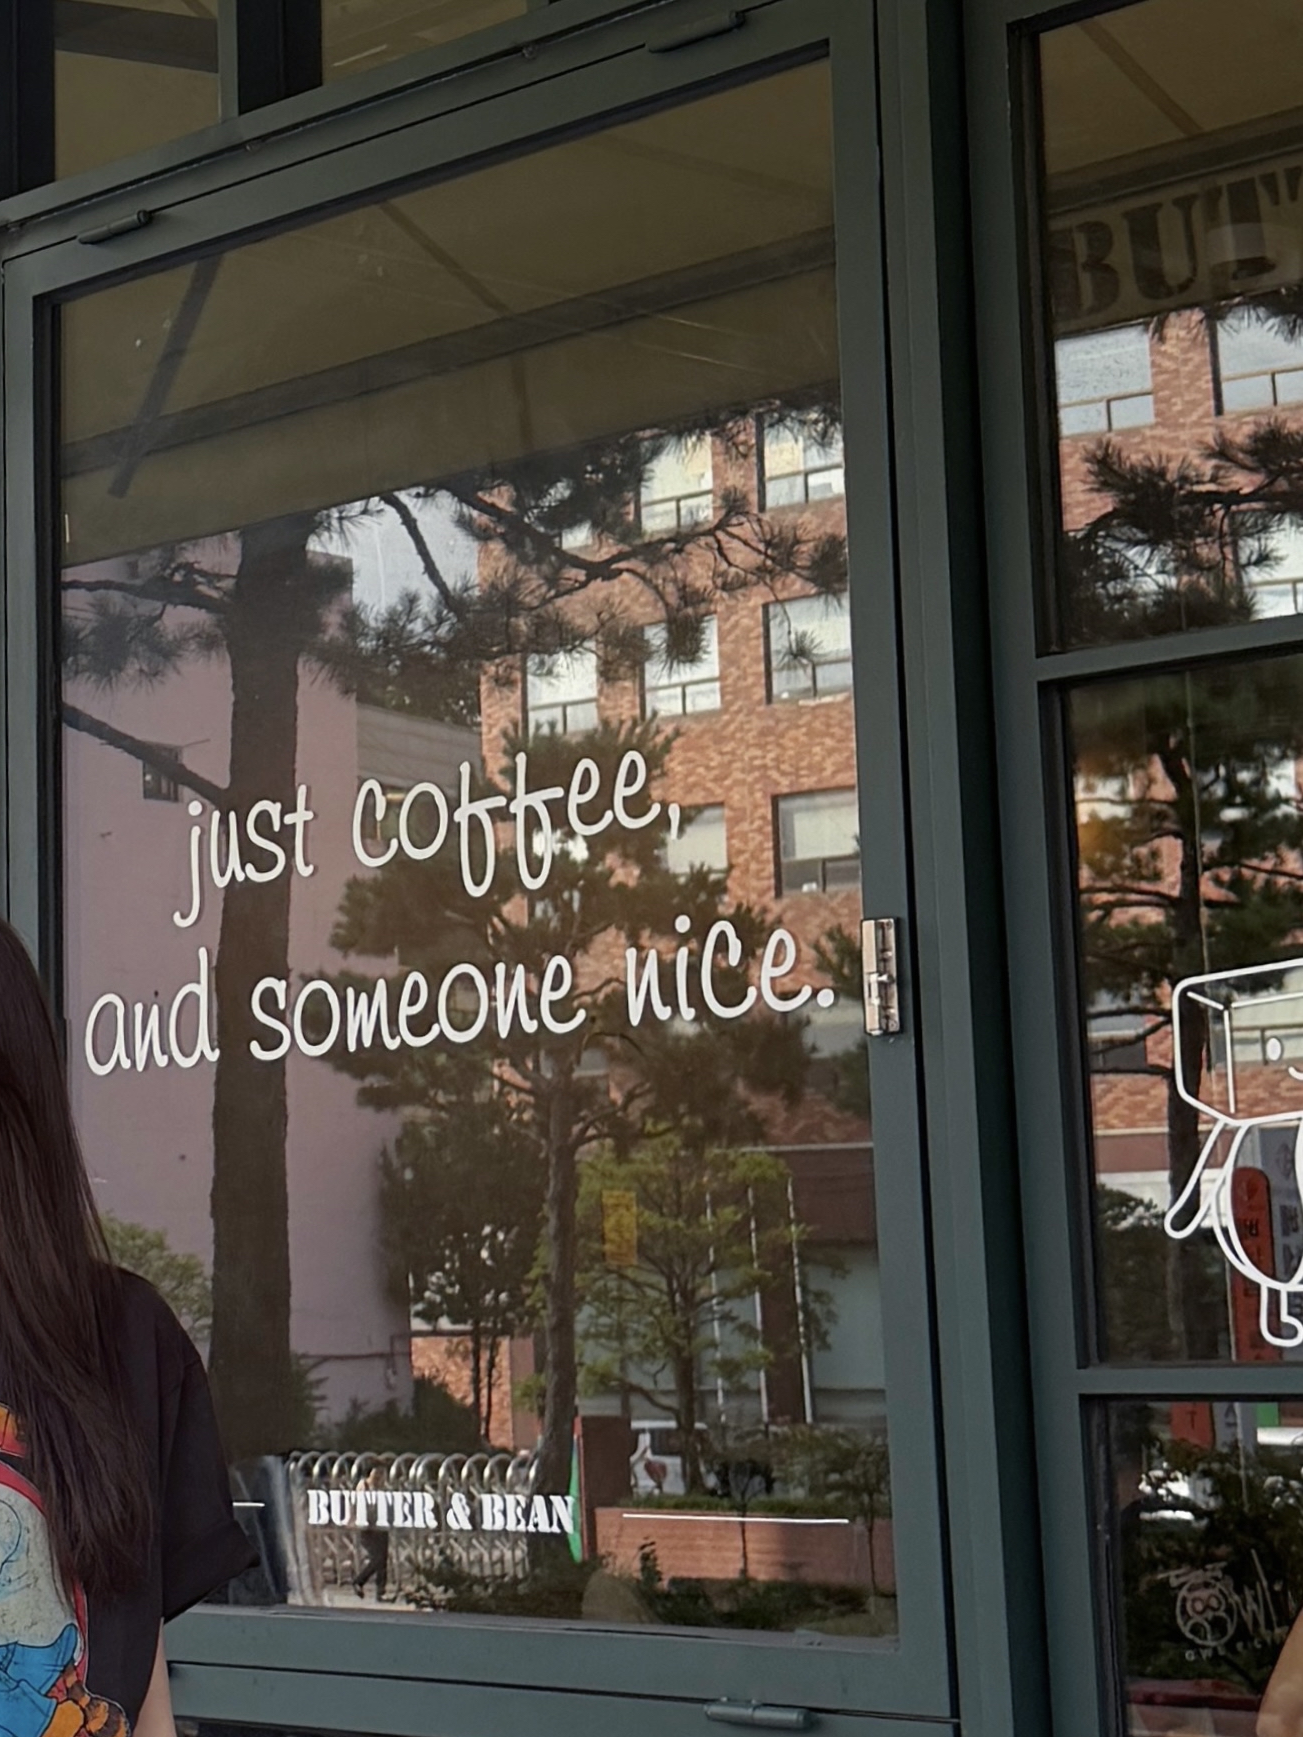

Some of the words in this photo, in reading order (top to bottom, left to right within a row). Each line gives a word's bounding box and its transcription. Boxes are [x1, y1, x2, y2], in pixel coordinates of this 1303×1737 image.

[173, 784, 315, 928] just
[352, 750, 682, 898] coffee,
[84, 947, 220, 1077] and
[249, 955, 585, 1060] someone
[625, 914, 835, 1029] nice.
[306, 1488, 438, 1530] BUTTER
[446, 1492, 473, 1531] &
[481, 1492, 576, 1534] BEAN
